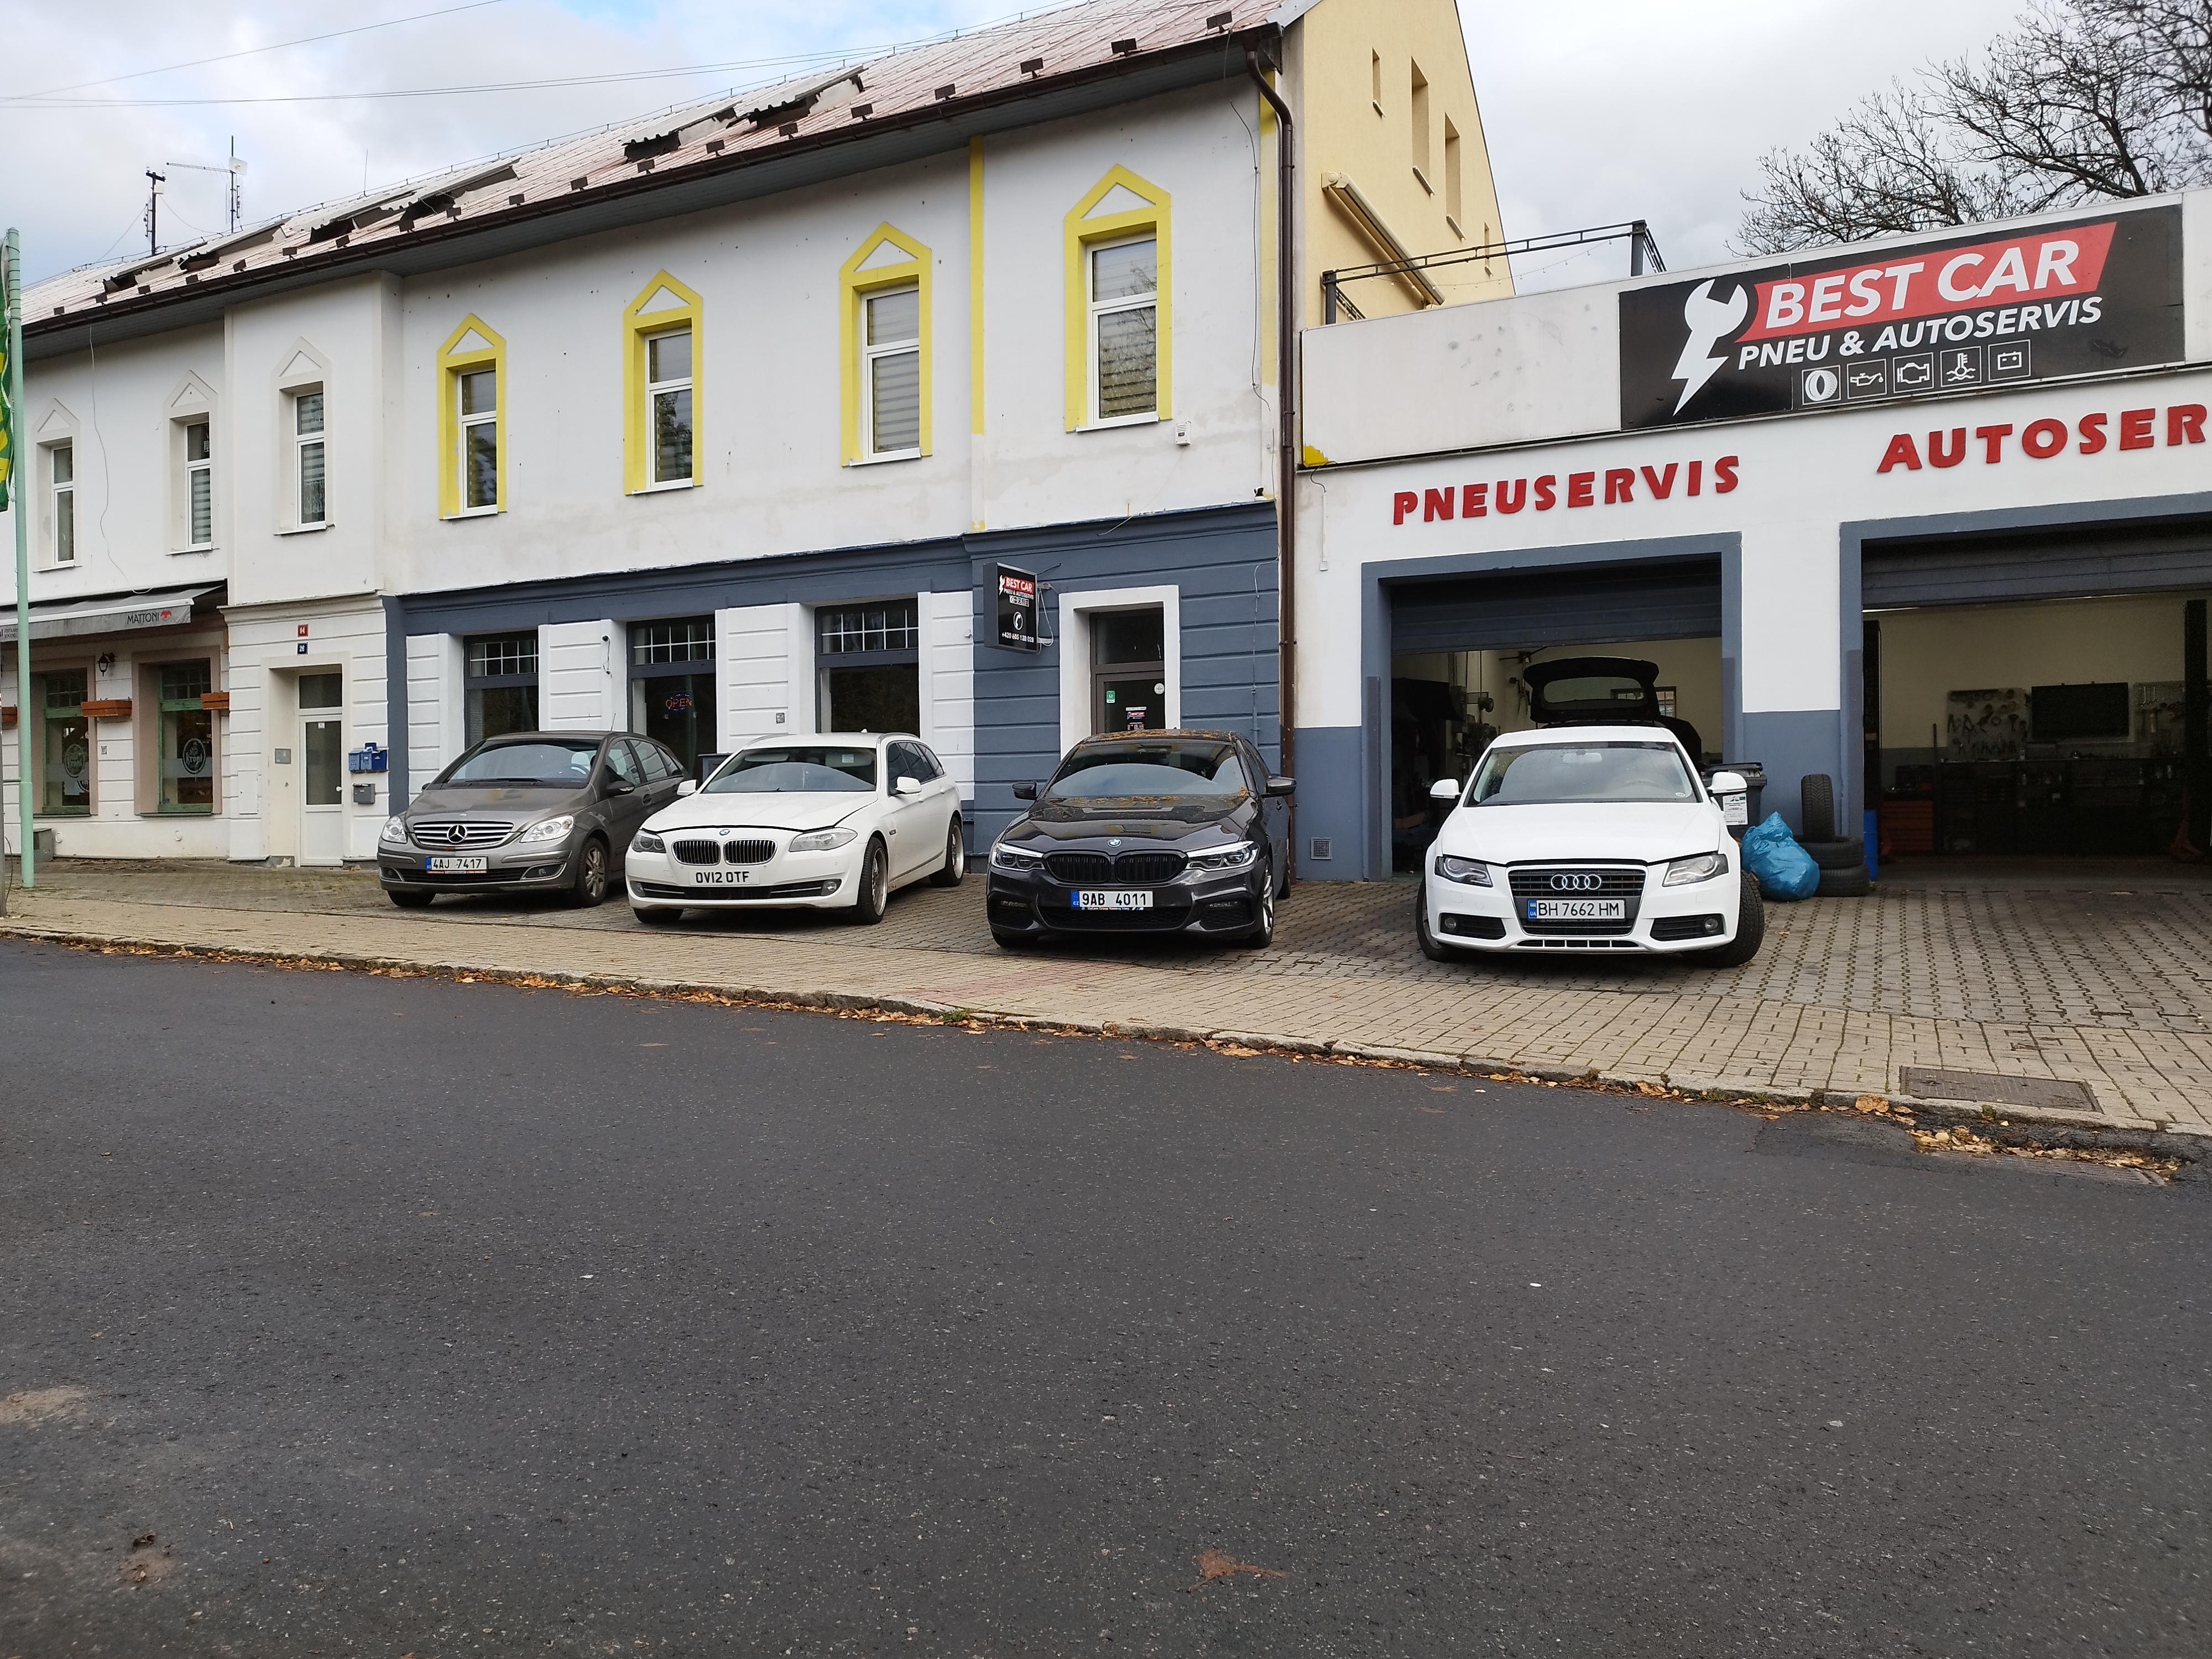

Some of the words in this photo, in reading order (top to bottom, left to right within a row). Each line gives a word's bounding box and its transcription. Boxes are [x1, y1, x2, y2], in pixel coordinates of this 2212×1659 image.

[1766, 262, 1924, 329] BEST
[1938, 239, 2079, 302] CAR
[1739, 335, 1830, 370] PNEU
[1839, 331, 1865, 355] &
[1871, 296, 2103, 352] AUTOSERVIS
[1876, 403, 2208, 473] AUTOSER
[1393, 455, 1740, 525] PNEUSERVIS
[1006, 577, 1020, 589] BEST
[1020, 581, 1032, 593] CAR
[127, 612, 159, 625] MATTONI
[665, 698, 693, 708] OPEN
[433, 859, 450, 869] 4AJ
[456, 858, 482, 869] 7417
[696, 872, 723, 883] OV12
[726, 871, 750, 883] OTF
[1082, 893, 1105, 906] 9AB
[1115, 893, 1146, 906] 4011
[1538, 902, 1558, 916] BH
[1562, 902, 1595, 916] 7662
[1599, 902, 1620, 916] HM
